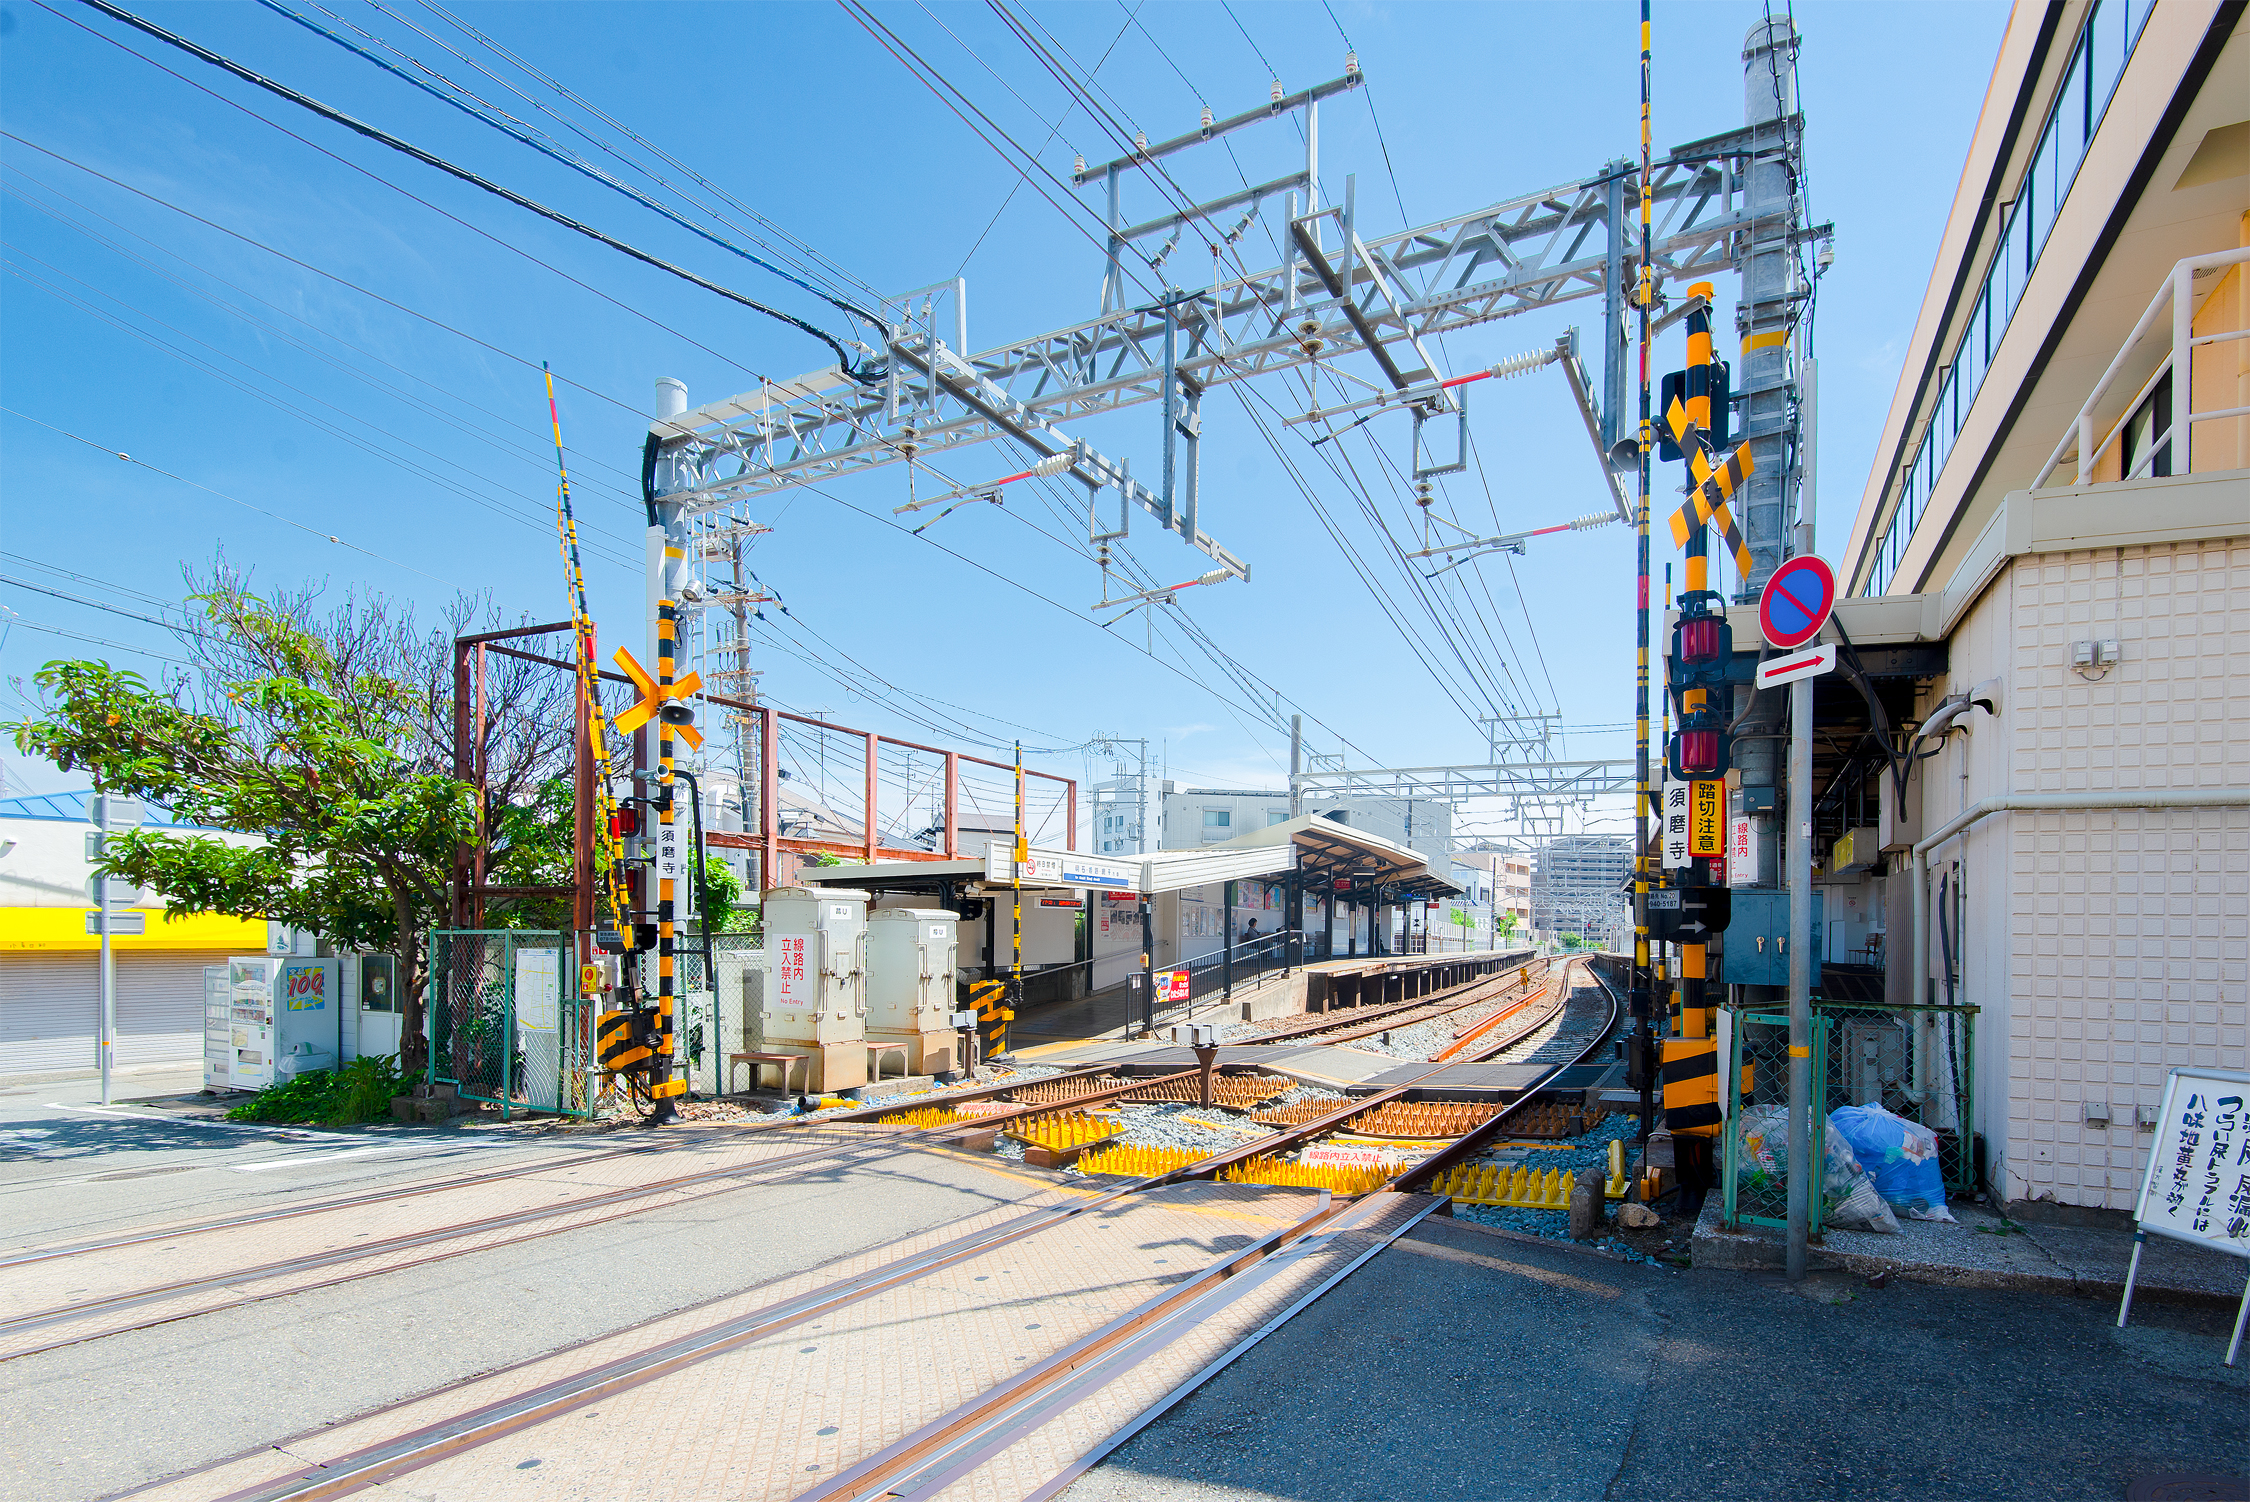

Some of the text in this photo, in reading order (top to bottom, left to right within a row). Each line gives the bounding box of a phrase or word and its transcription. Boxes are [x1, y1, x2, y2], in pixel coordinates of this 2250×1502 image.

[1668, 787, 1686, 860] 須磨寺
[1697, 783, 1716, 852] 踏切注意
[1737, 822, 1748, 858] 線路内
[661, 829, 676, 874] 須磨寺
[1648, 900, 1677, 908] -940-5187
[780, 937, 792, 994] 立入禁止
[793, 938, 805, 981] 線路内
[789, 998, 804, 1006] Entry
[1308, 1151, 1382, 1163] 線路内立入禁止
[2166, 1093, 2208, 1218] 八味地黄丸が効く
[2192, 1095, 2244, 1233] つらい尿トラブルには
